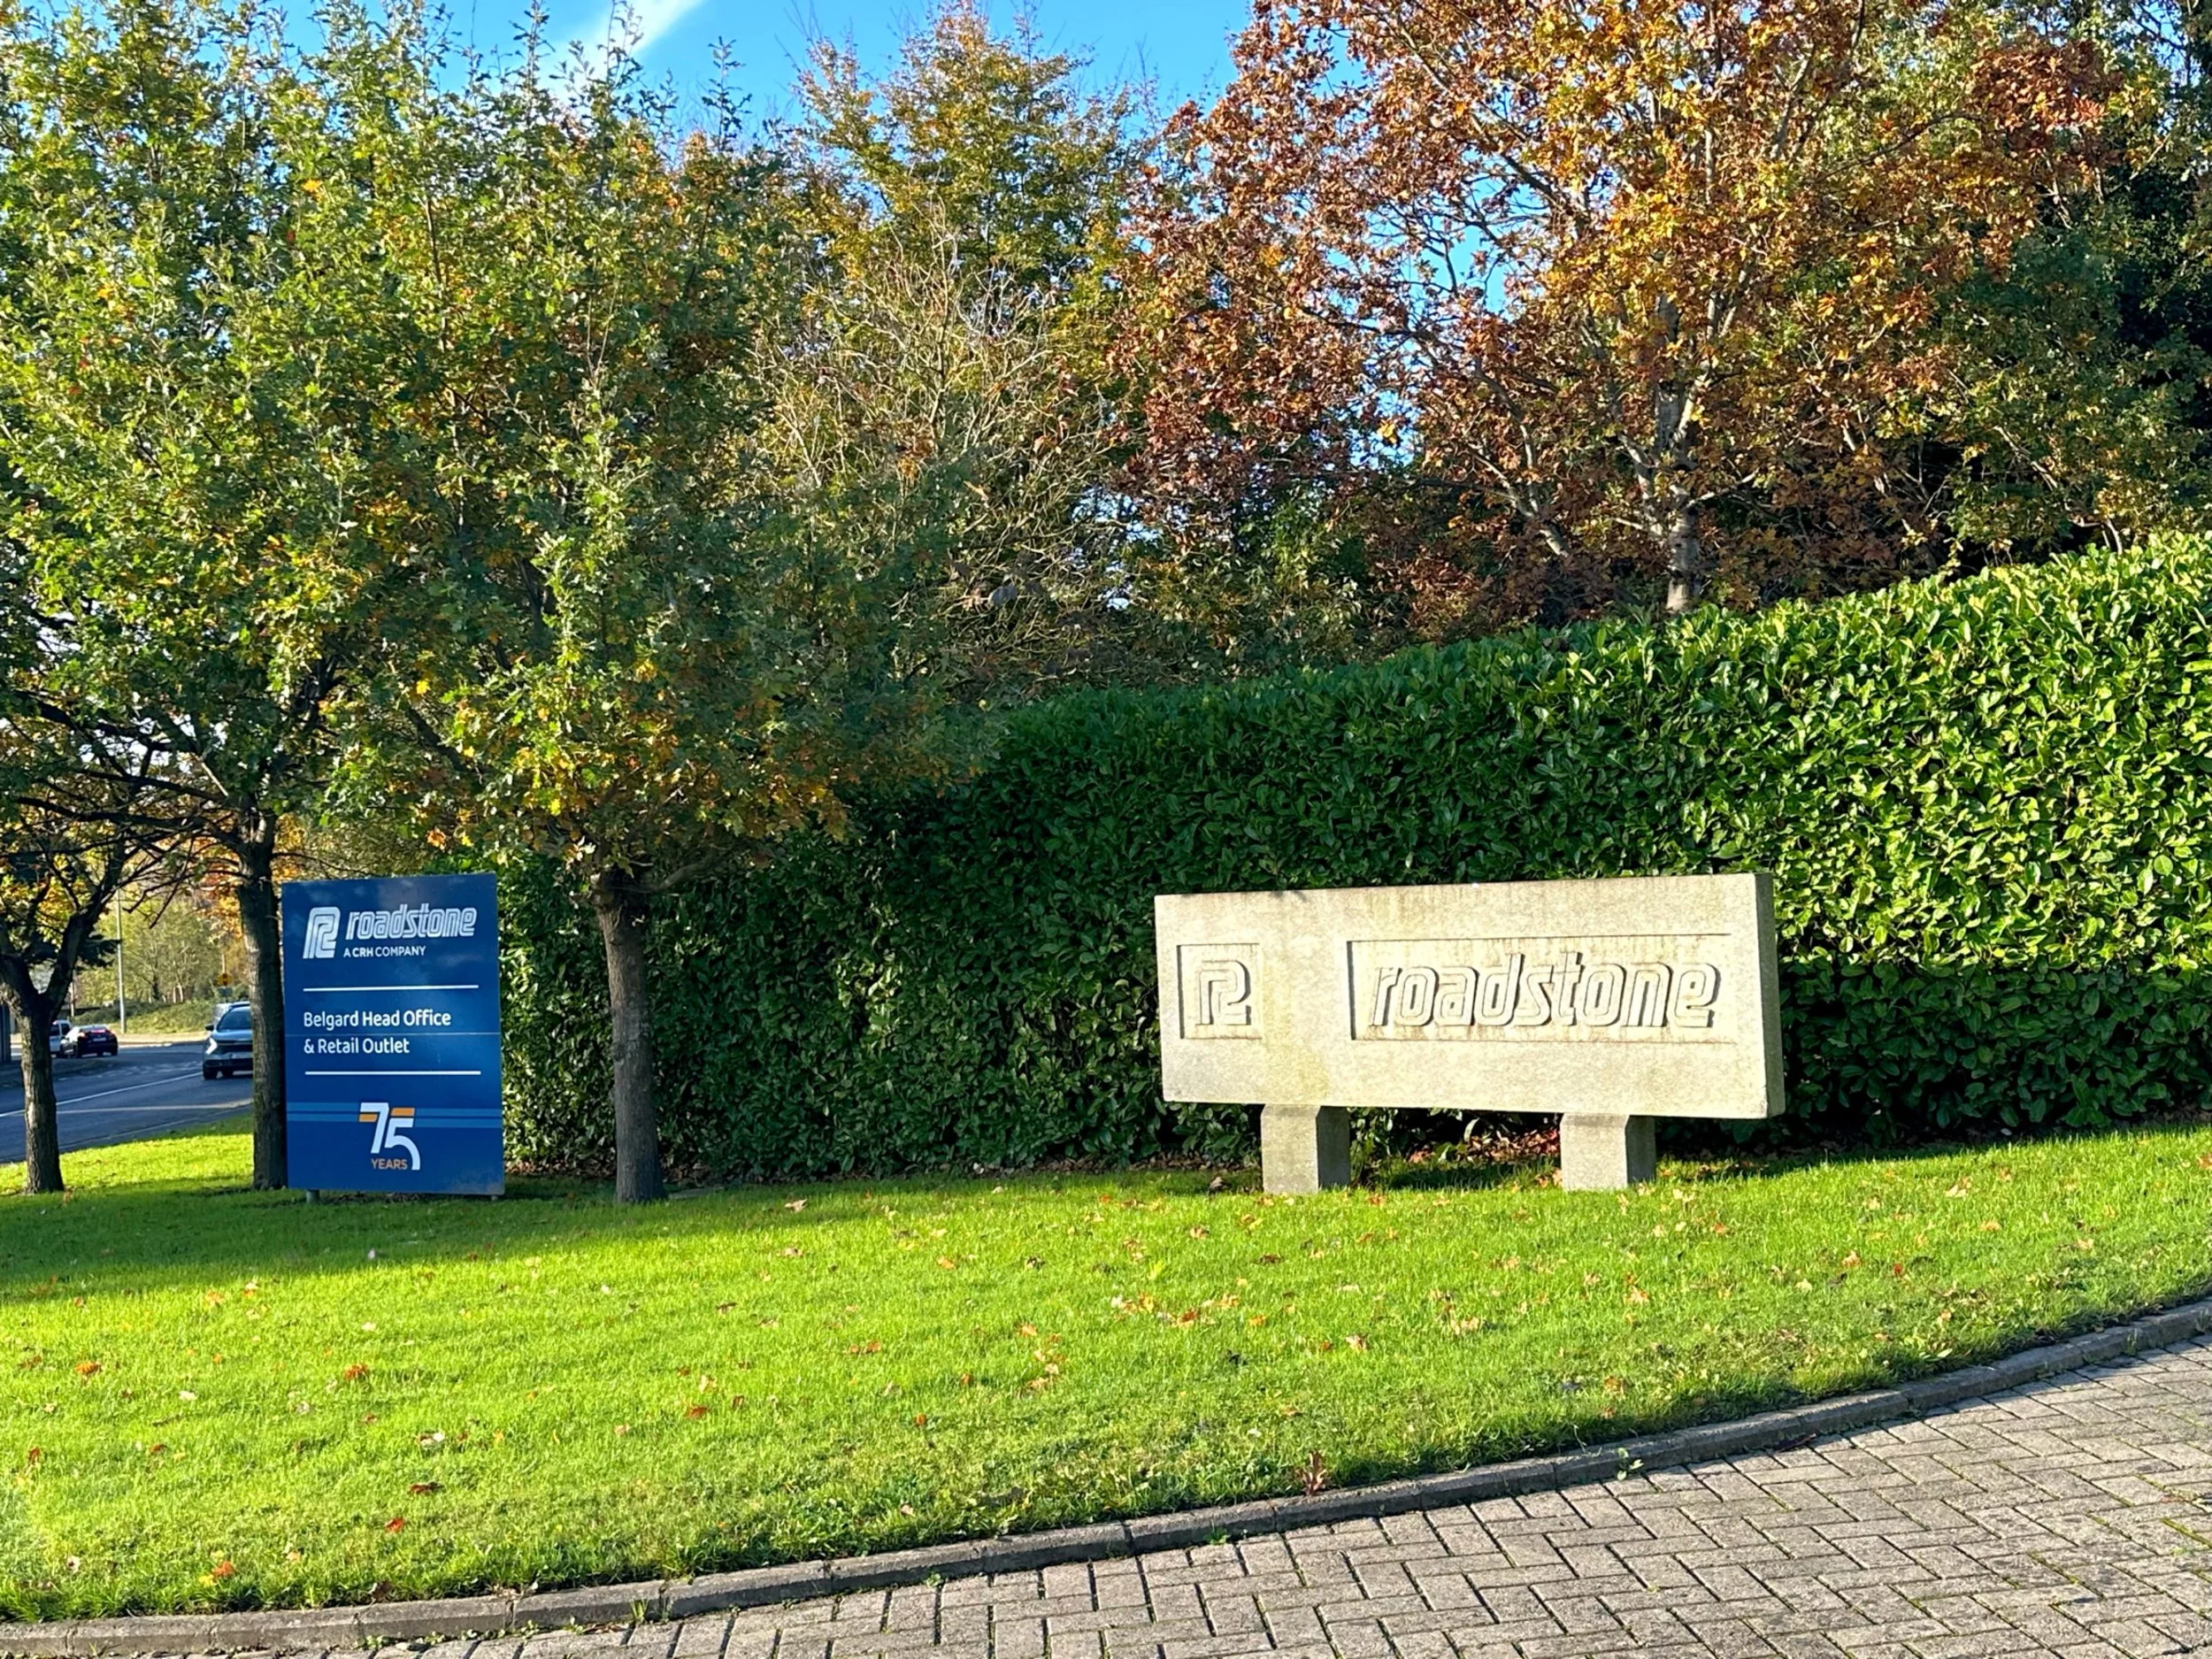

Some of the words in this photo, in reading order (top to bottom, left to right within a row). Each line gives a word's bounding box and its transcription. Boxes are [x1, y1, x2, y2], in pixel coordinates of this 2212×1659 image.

[346, 903, 477, 940] roadstone
[344, 948, 351, 957] A
[352, 946, 374, 957] CRH
[375, 945, 426, 957] COMPANY
[1371, 951, 1720, 1028] roadstone
[303, 1011, 359, 1031] Belgard
[362, 1010, 400, 1026] Head
[403, 1009, 451, 1026] Office
[303, 1039, 315, 1054] &
[318, 1038, 359, 1054] Retail
[362, 1037, 410, 1054] Outlet
[358, 1102, 420, 1171] 75
[371, 1158, 408, 1170] YEARS
